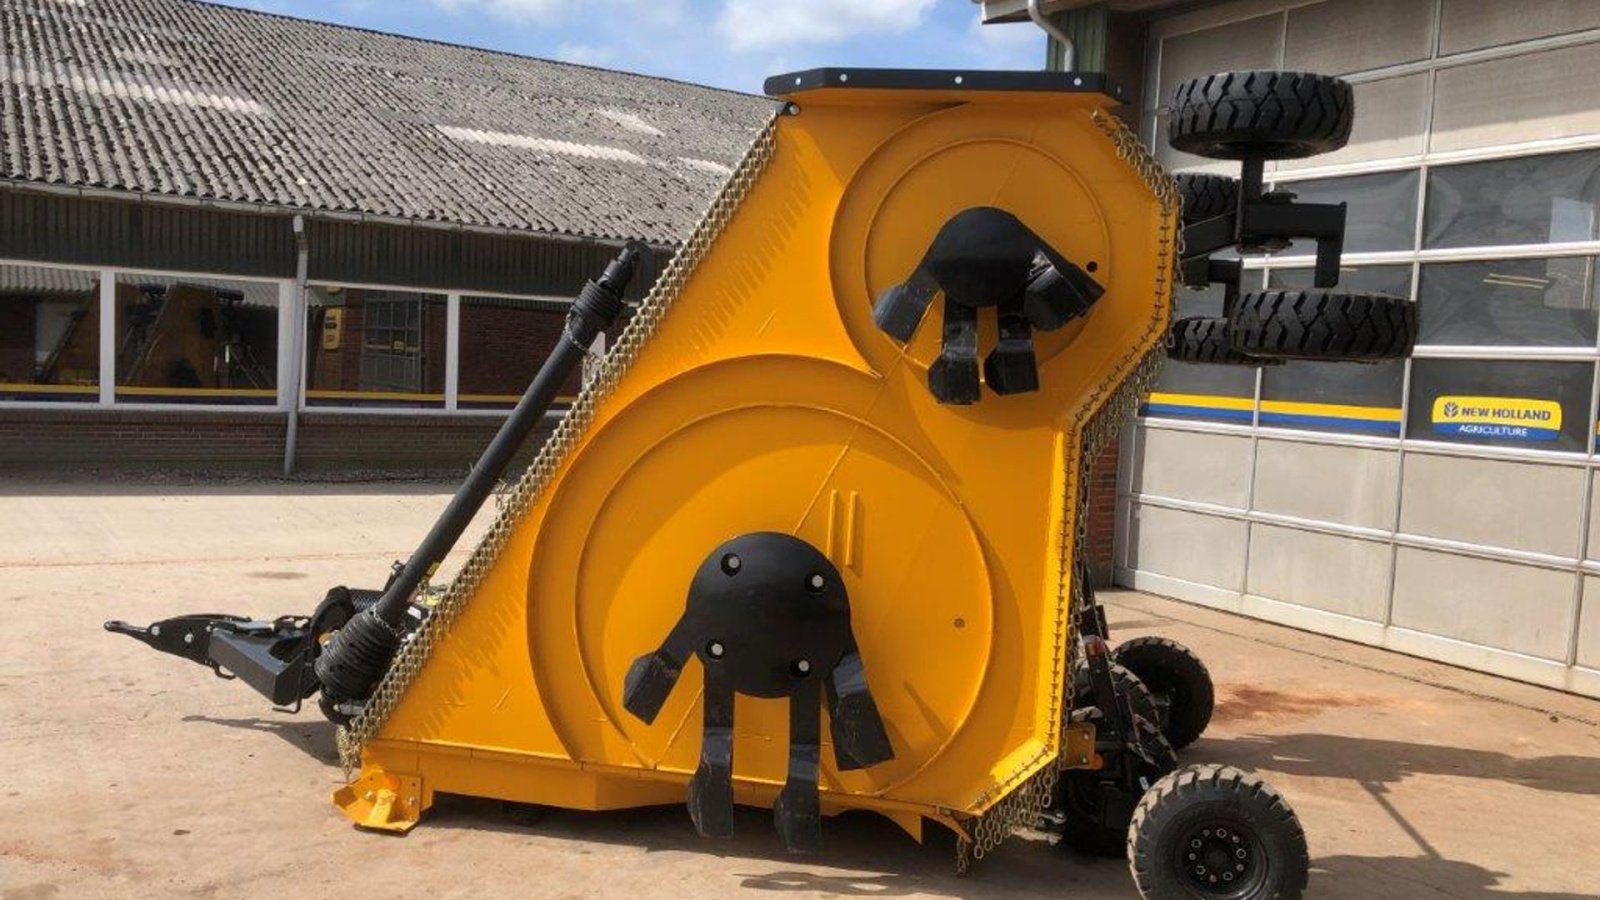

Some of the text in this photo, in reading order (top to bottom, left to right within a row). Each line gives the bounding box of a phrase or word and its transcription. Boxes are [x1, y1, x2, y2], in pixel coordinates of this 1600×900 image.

[1462, 407, 1551, 421] NEW HOLLAND
[1459, 425, 1528, 436] AGRICULTURE
